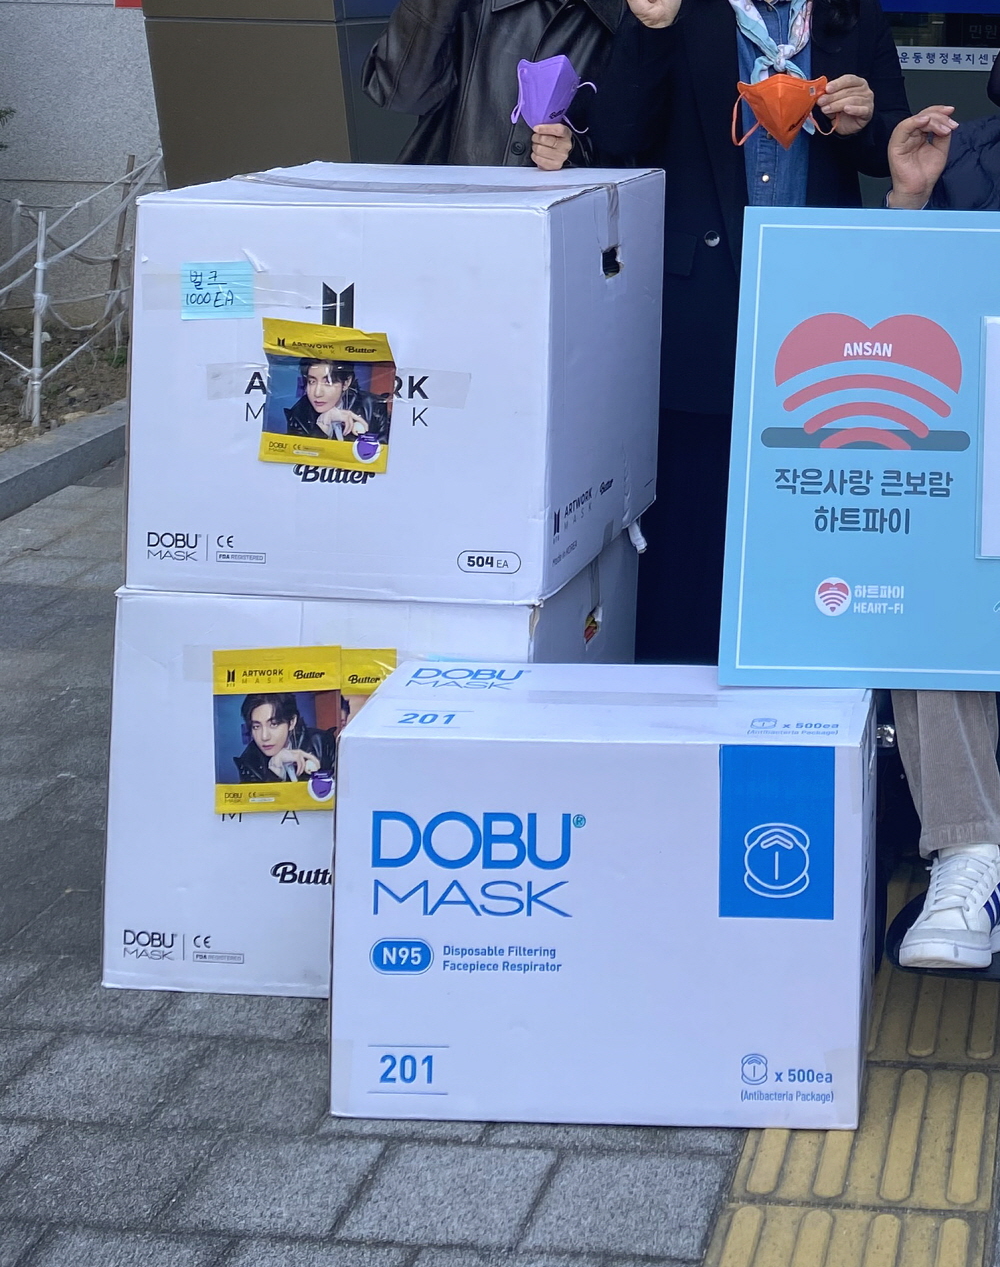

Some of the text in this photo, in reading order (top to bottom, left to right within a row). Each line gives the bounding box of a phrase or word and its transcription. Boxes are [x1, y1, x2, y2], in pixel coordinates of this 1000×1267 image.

[344, 345, 377, 354] Butter
[843, 341, 892, 357] ANSAN
[775, 468, 954, 498] 작은사랑 큰보람
[564, 487, 593, 518] ARTWORK
[814, 505, 910, 535] 하트파이
[147, 532, 234, 548] DOBU CE
[147, 550, 198, 562] MASK
[467, 556, 509, 569] 504 EA
[854, 584, 905, 599] 하트파이
[853, 602, 904, 614] HEART-FI
[241, 668, 326, 680] ARTWORK Butter
[348, 674, 380, 685] Butter
[405, 680, 515, 690] MASK
[398, 712, 456, 725] 201
[795, 722, 840, 730] 500ea
[373, 879, 573, 917] MASK
[123, 929, 212, 948] DOBU CE
[123, 947, 174, 961] MASK
[382, 946, 422, 966] N95
[443, 945, 556, 960] Disposable Filtering
[442, 960, 562, 974] Facepiece Respirator
[380, 1054, 434, 1084] 201
[774, 1068, 833, 1084] x 500ea
[740, 1090, 834, 1104] (Antibacteria Package)
